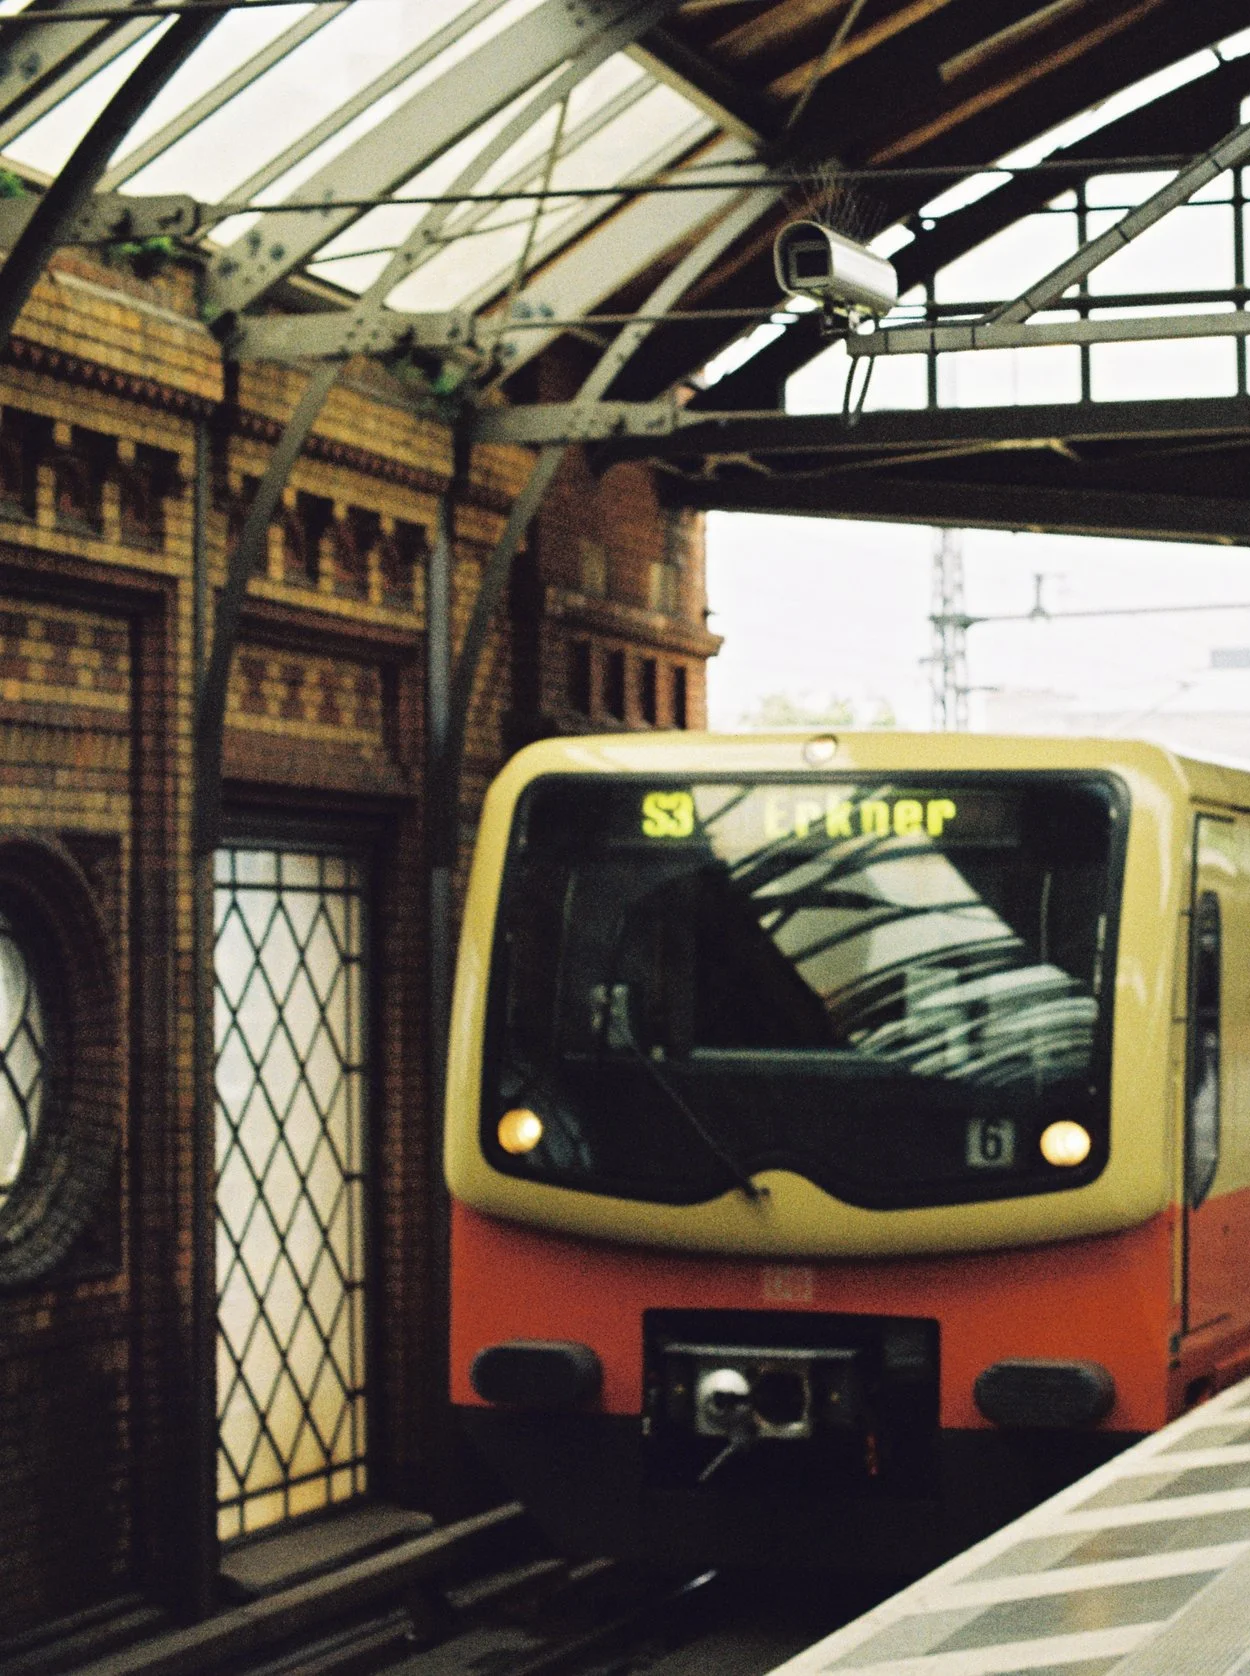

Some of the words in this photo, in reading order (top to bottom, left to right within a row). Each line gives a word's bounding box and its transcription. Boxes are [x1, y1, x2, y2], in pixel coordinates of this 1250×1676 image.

[642, 791, 695, 838] S3
[763, 792, 957, 839] Erkner
[980, 1118, 1002, 1161] 6
